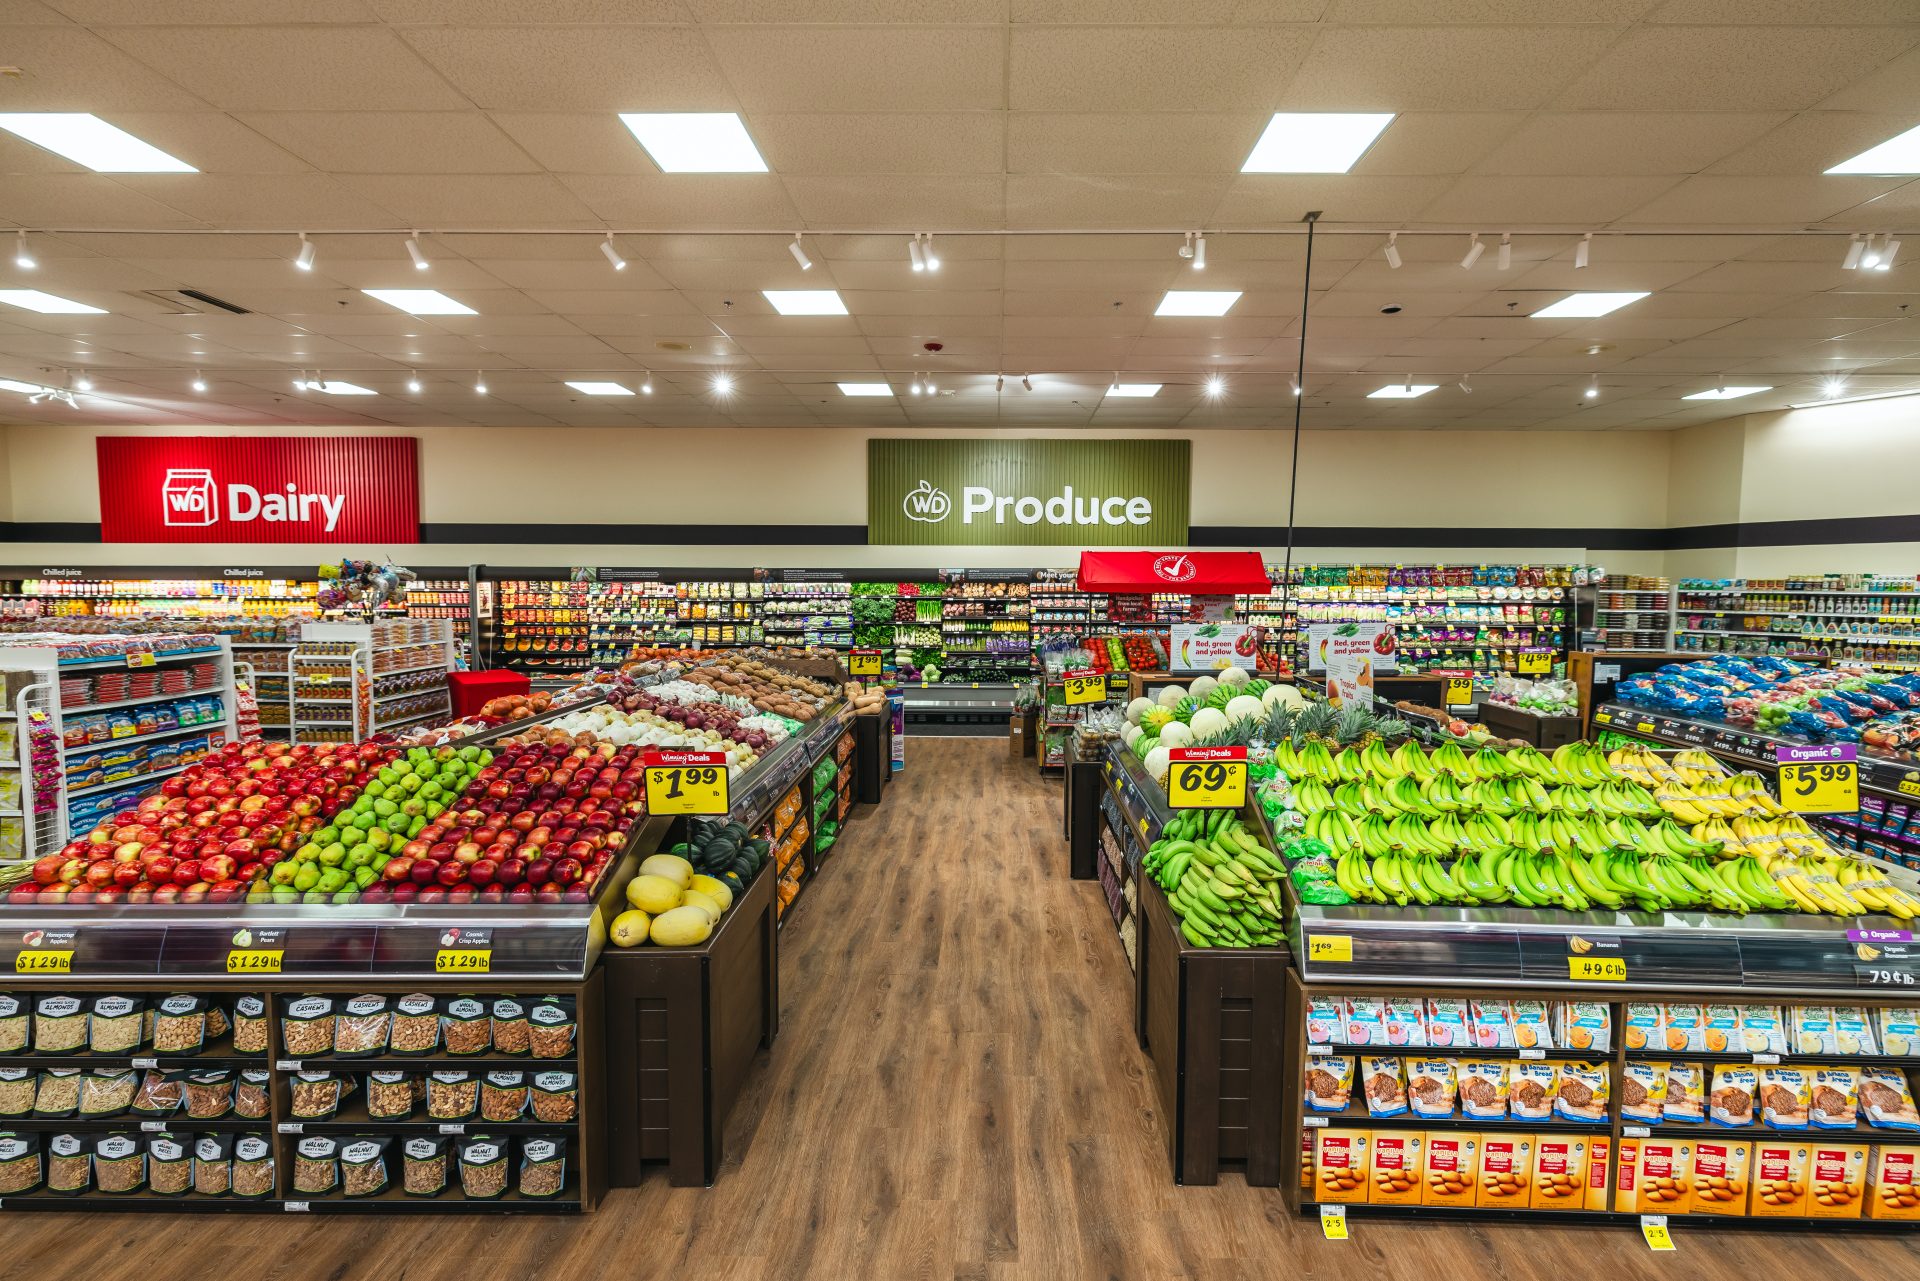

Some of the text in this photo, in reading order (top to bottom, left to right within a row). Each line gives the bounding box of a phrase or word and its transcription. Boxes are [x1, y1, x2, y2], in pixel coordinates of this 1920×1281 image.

[169, 485, 204, 512] WD
[912, 488, 946, 514] WD
[227, 483, 346, 532] Dairy
[963, 486, 1152, 525] Produce
[42, 568, 82, 577] Chilled juice
[224, 568, 264, 577] Chilled juice
[1040, 571, 1057, 579] Meet
[1196, 641, 1232, 650] Red, green
[1334, 639, 1371, 649] Red, green
[1209, 648, 1232, 657] yellow
[1334, 647, 1371, 656] and yellow
[1339, 678, 1356, 691] Tropical
[1341, 689, 1354, 700] fruits
[1185, 749, 1232, 760] Winning Deals
[1791, 747, 1828, 760] Organic
[661, 753, 711, 765] Winning Deals
[1870, 931, 1901, 940] Organic
[1884, 946, 1906, 954] Organic
[167, 1001, 192, 1009] CASHEWS
[296, 1004, 325, 1012] CASHEWS
[1626, 1061, 1651, 1070] Banana
[1775, 1069, 1800, 1077] Banana
[349, 1146, 373, 1154] WALNUT
